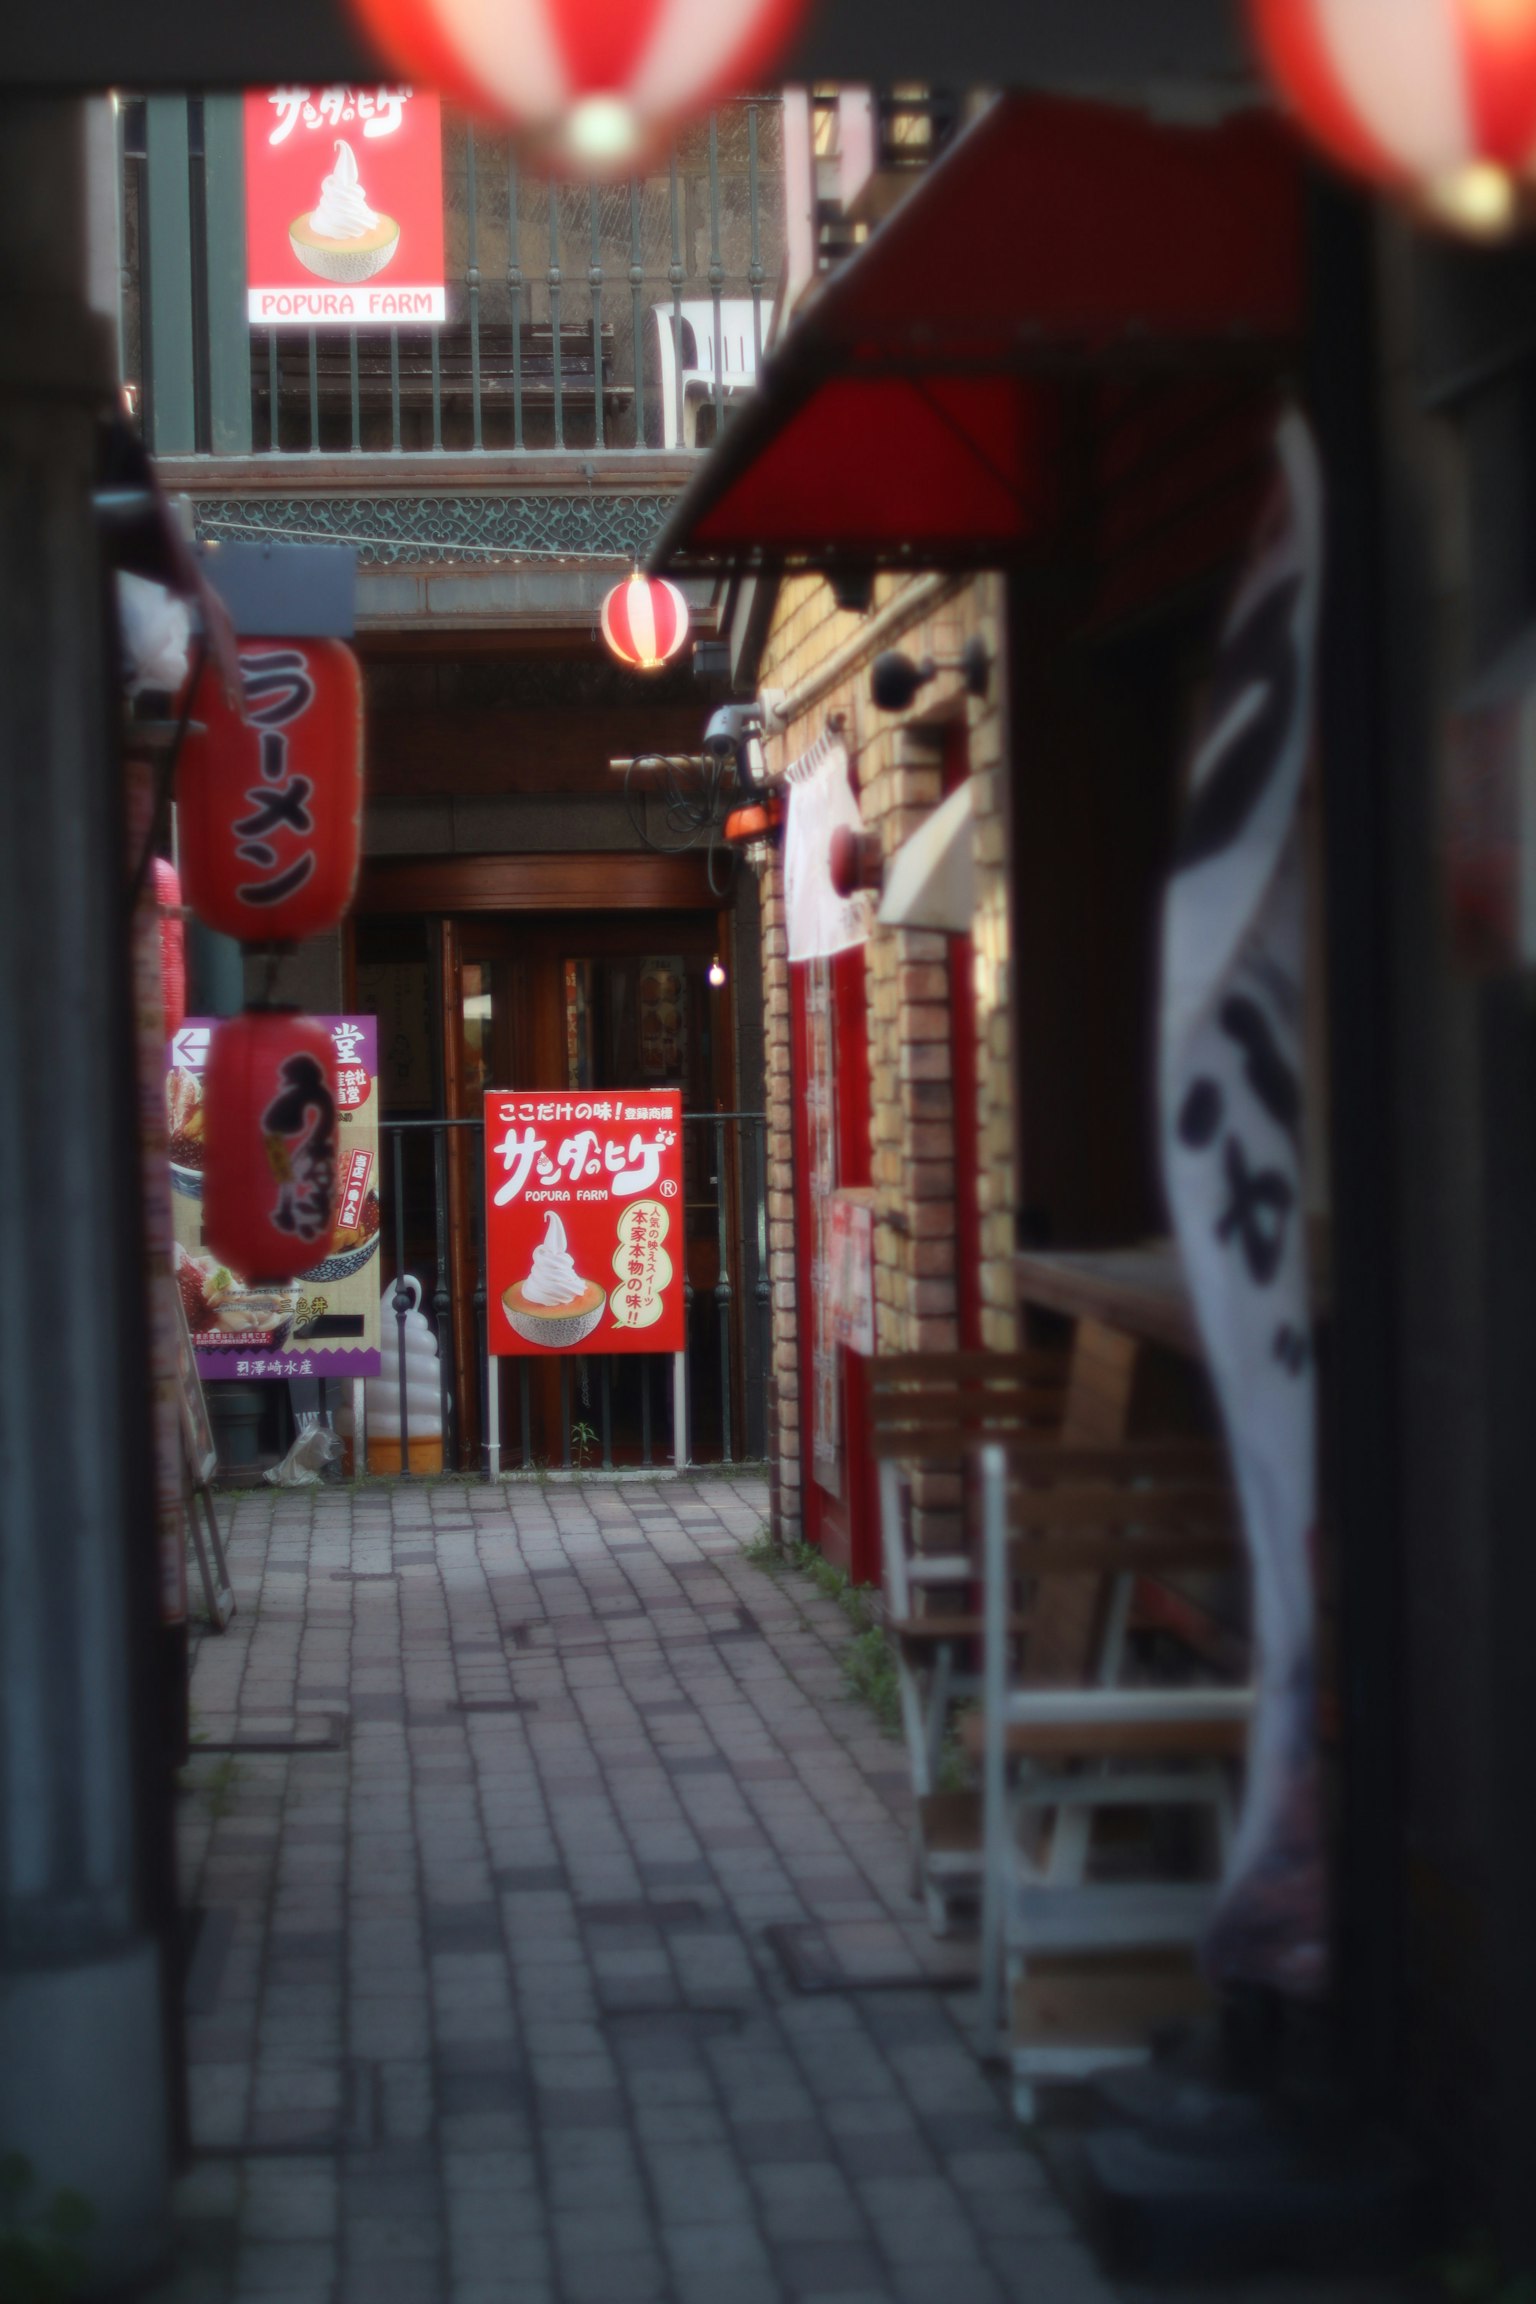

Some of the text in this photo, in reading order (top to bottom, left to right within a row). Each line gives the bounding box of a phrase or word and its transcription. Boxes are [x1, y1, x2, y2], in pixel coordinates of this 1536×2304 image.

[261, 293, 433, 316] POPURA FARM
[232, 649, 316, 907] ラーメン
[331, 1022, 366, 1064] 堂
[499, 1101, 623, 1122] ここだけの味!
[624, 1106, 674, 1121] 登録商標
[525, 1190, 608, 1202] POPURA FARM
[643, 1205, 661, 1307] 人気の映えスイーツ
